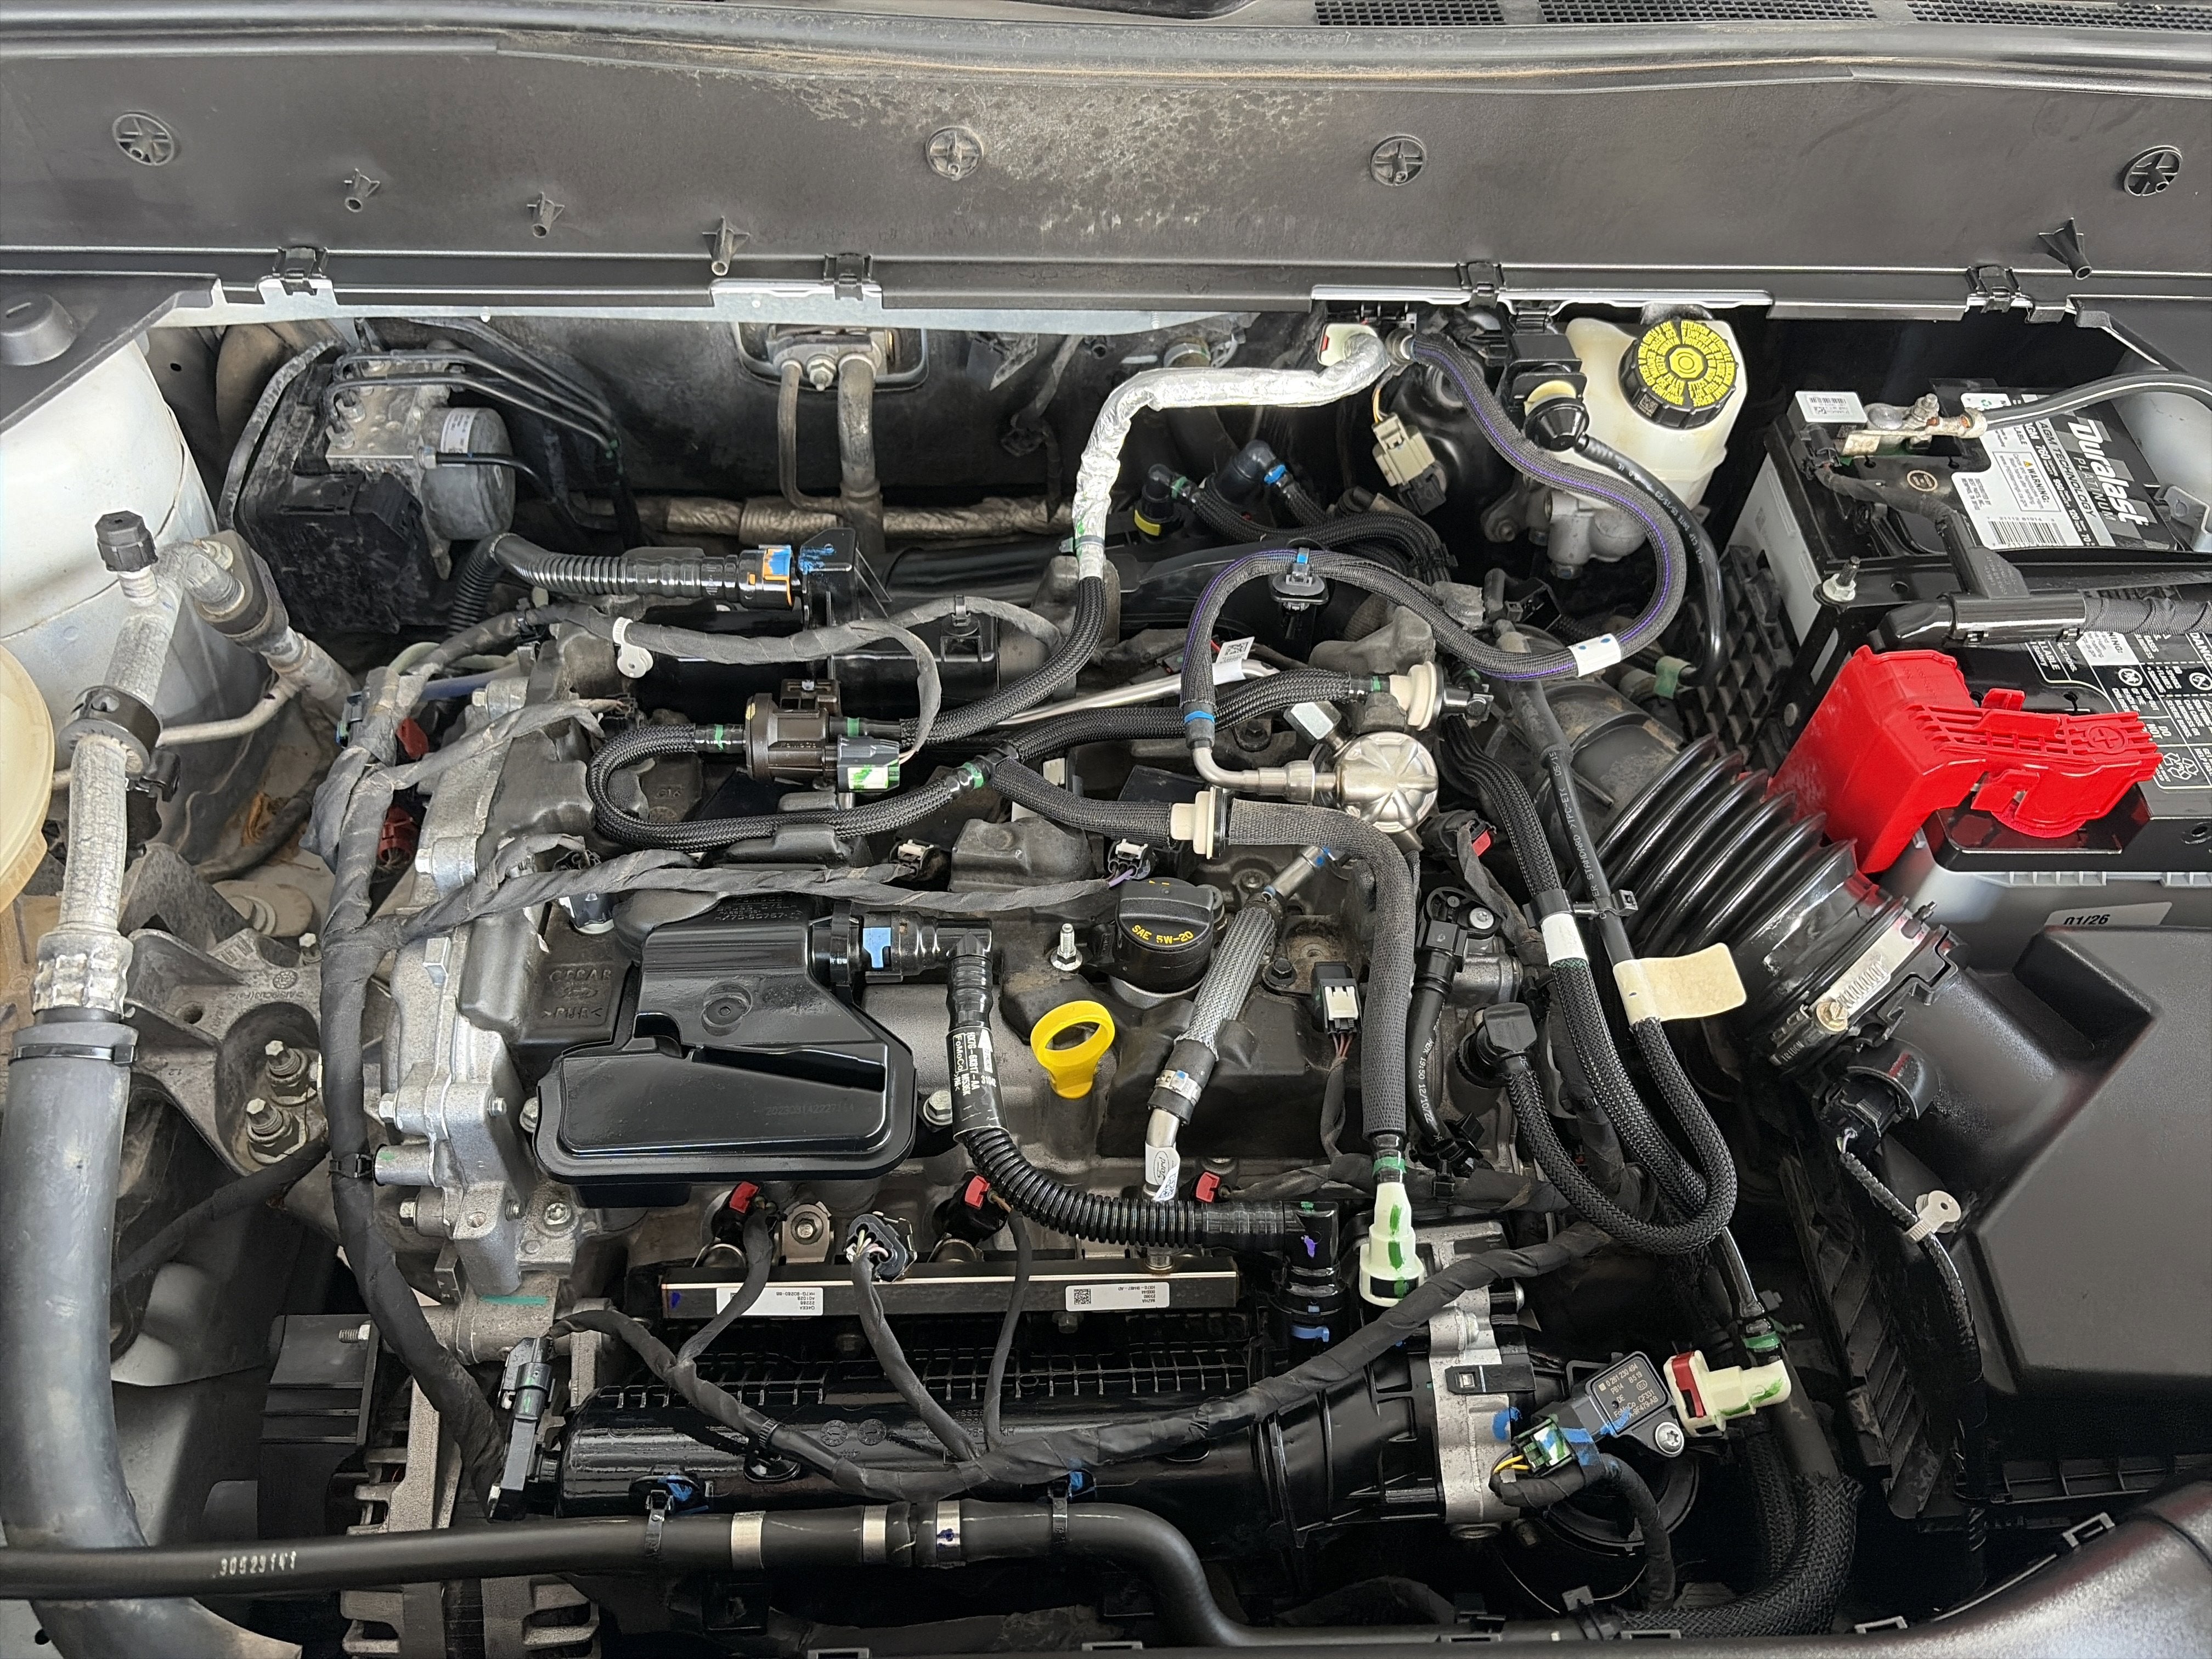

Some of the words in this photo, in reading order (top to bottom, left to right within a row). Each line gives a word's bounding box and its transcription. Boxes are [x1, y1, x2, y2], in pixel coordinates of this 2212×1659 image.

[2036, 444, 2051, 459] 760
[2039, 422, 2058, 445] AGM
[2053, 447, 2096, 517] TECHNOLOGY
[2027, 469, 2050, 503] WARNING:
[2073, 457, 2117, 521] PLATINUM
[2147, 724, 2163, 739] NOT
[2158, 726, 2171, 736] DO
[1572, 833, 1594, 880] STANDARD
[1132, 924, 1152, 940] SAE
[1156, 931, 1193, 944] 5W-20
[955, 1034, 964, 1070] FoMoCo
[1418, 1057, 1426, 1079] 19:50
[1417, 1083, 1434, 1124] 12/10/22
[1154, 1156, 1168, 1180] Ford
[1610, 1375, 1620, 1384] 261
[1619, 1369, 1628, 1378] 230
[1629, 1363, 1638, 1372] 494
[1611, 1383, 1624, 1395] PB14
[1616, 1395, 1626, 1403] DE
[1638, 1389, 1655, 1402] CF331
